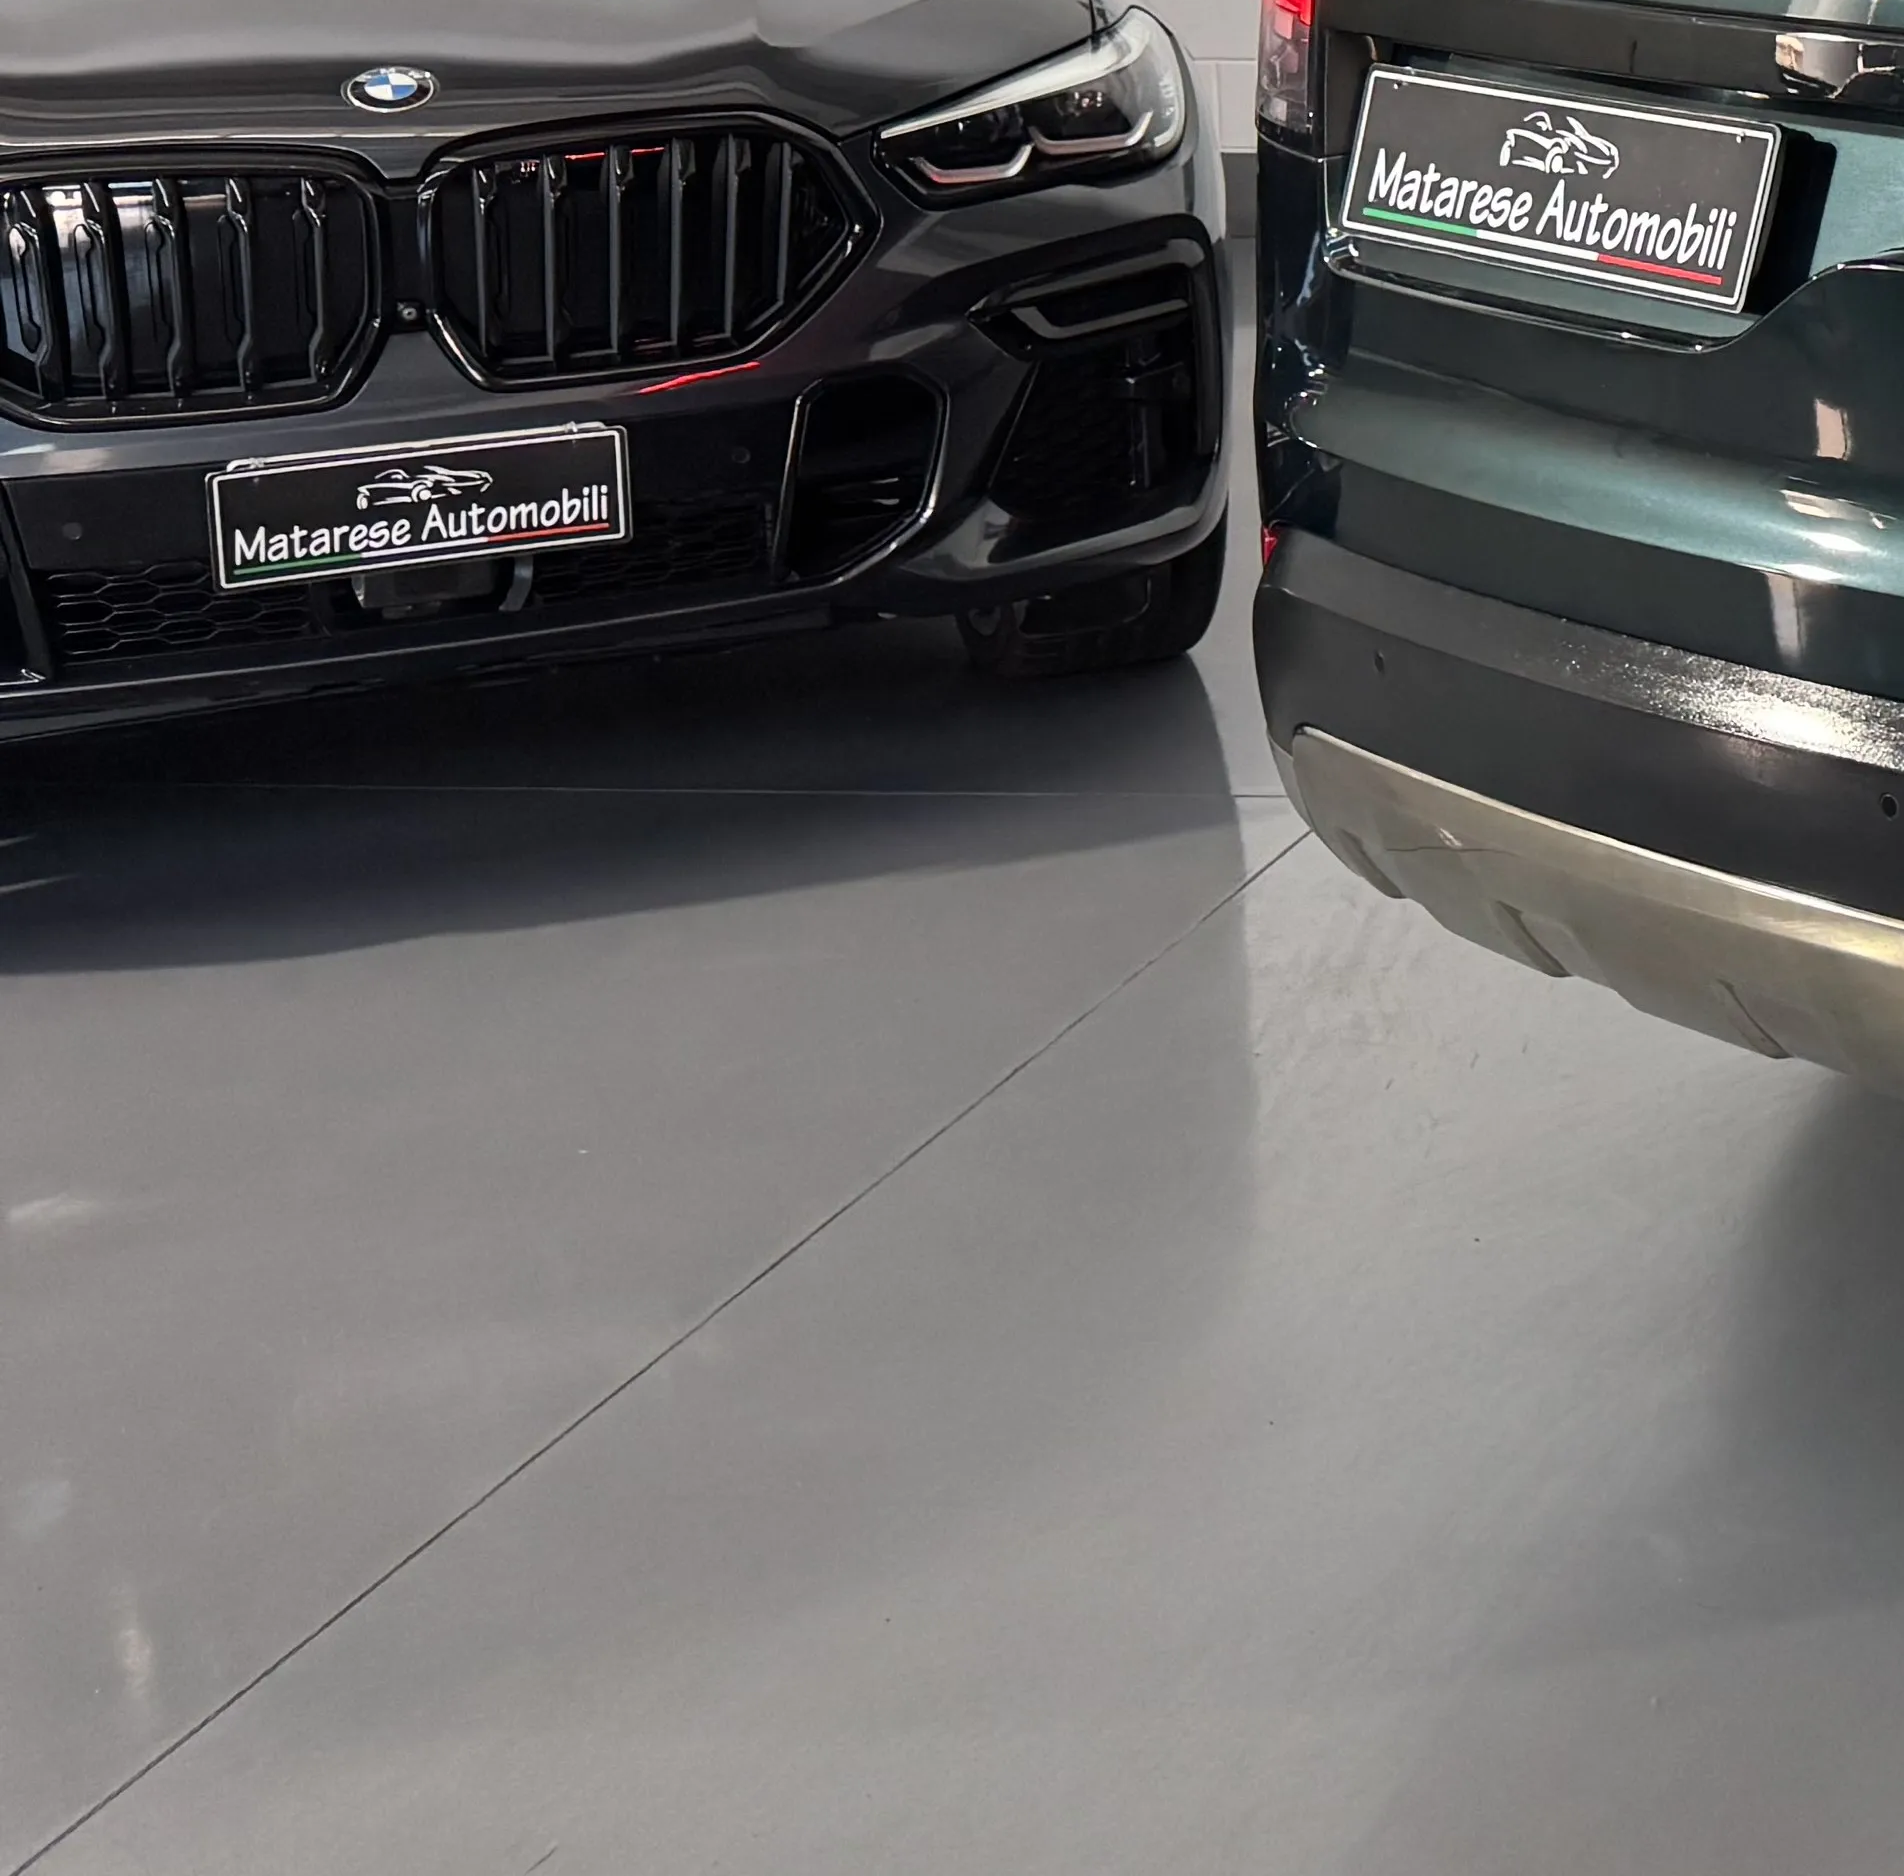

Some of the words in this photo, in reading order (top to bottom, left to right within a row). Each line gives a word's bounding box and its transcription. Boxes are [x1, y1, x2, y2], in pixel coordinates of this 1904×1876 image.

[1368, 147, 1531, 233] Matarese
[1535, 179, 1738, 271] Automobili
[235, 518, 412, 566] Matarese
[421, 484, 609, 541] Automobili
